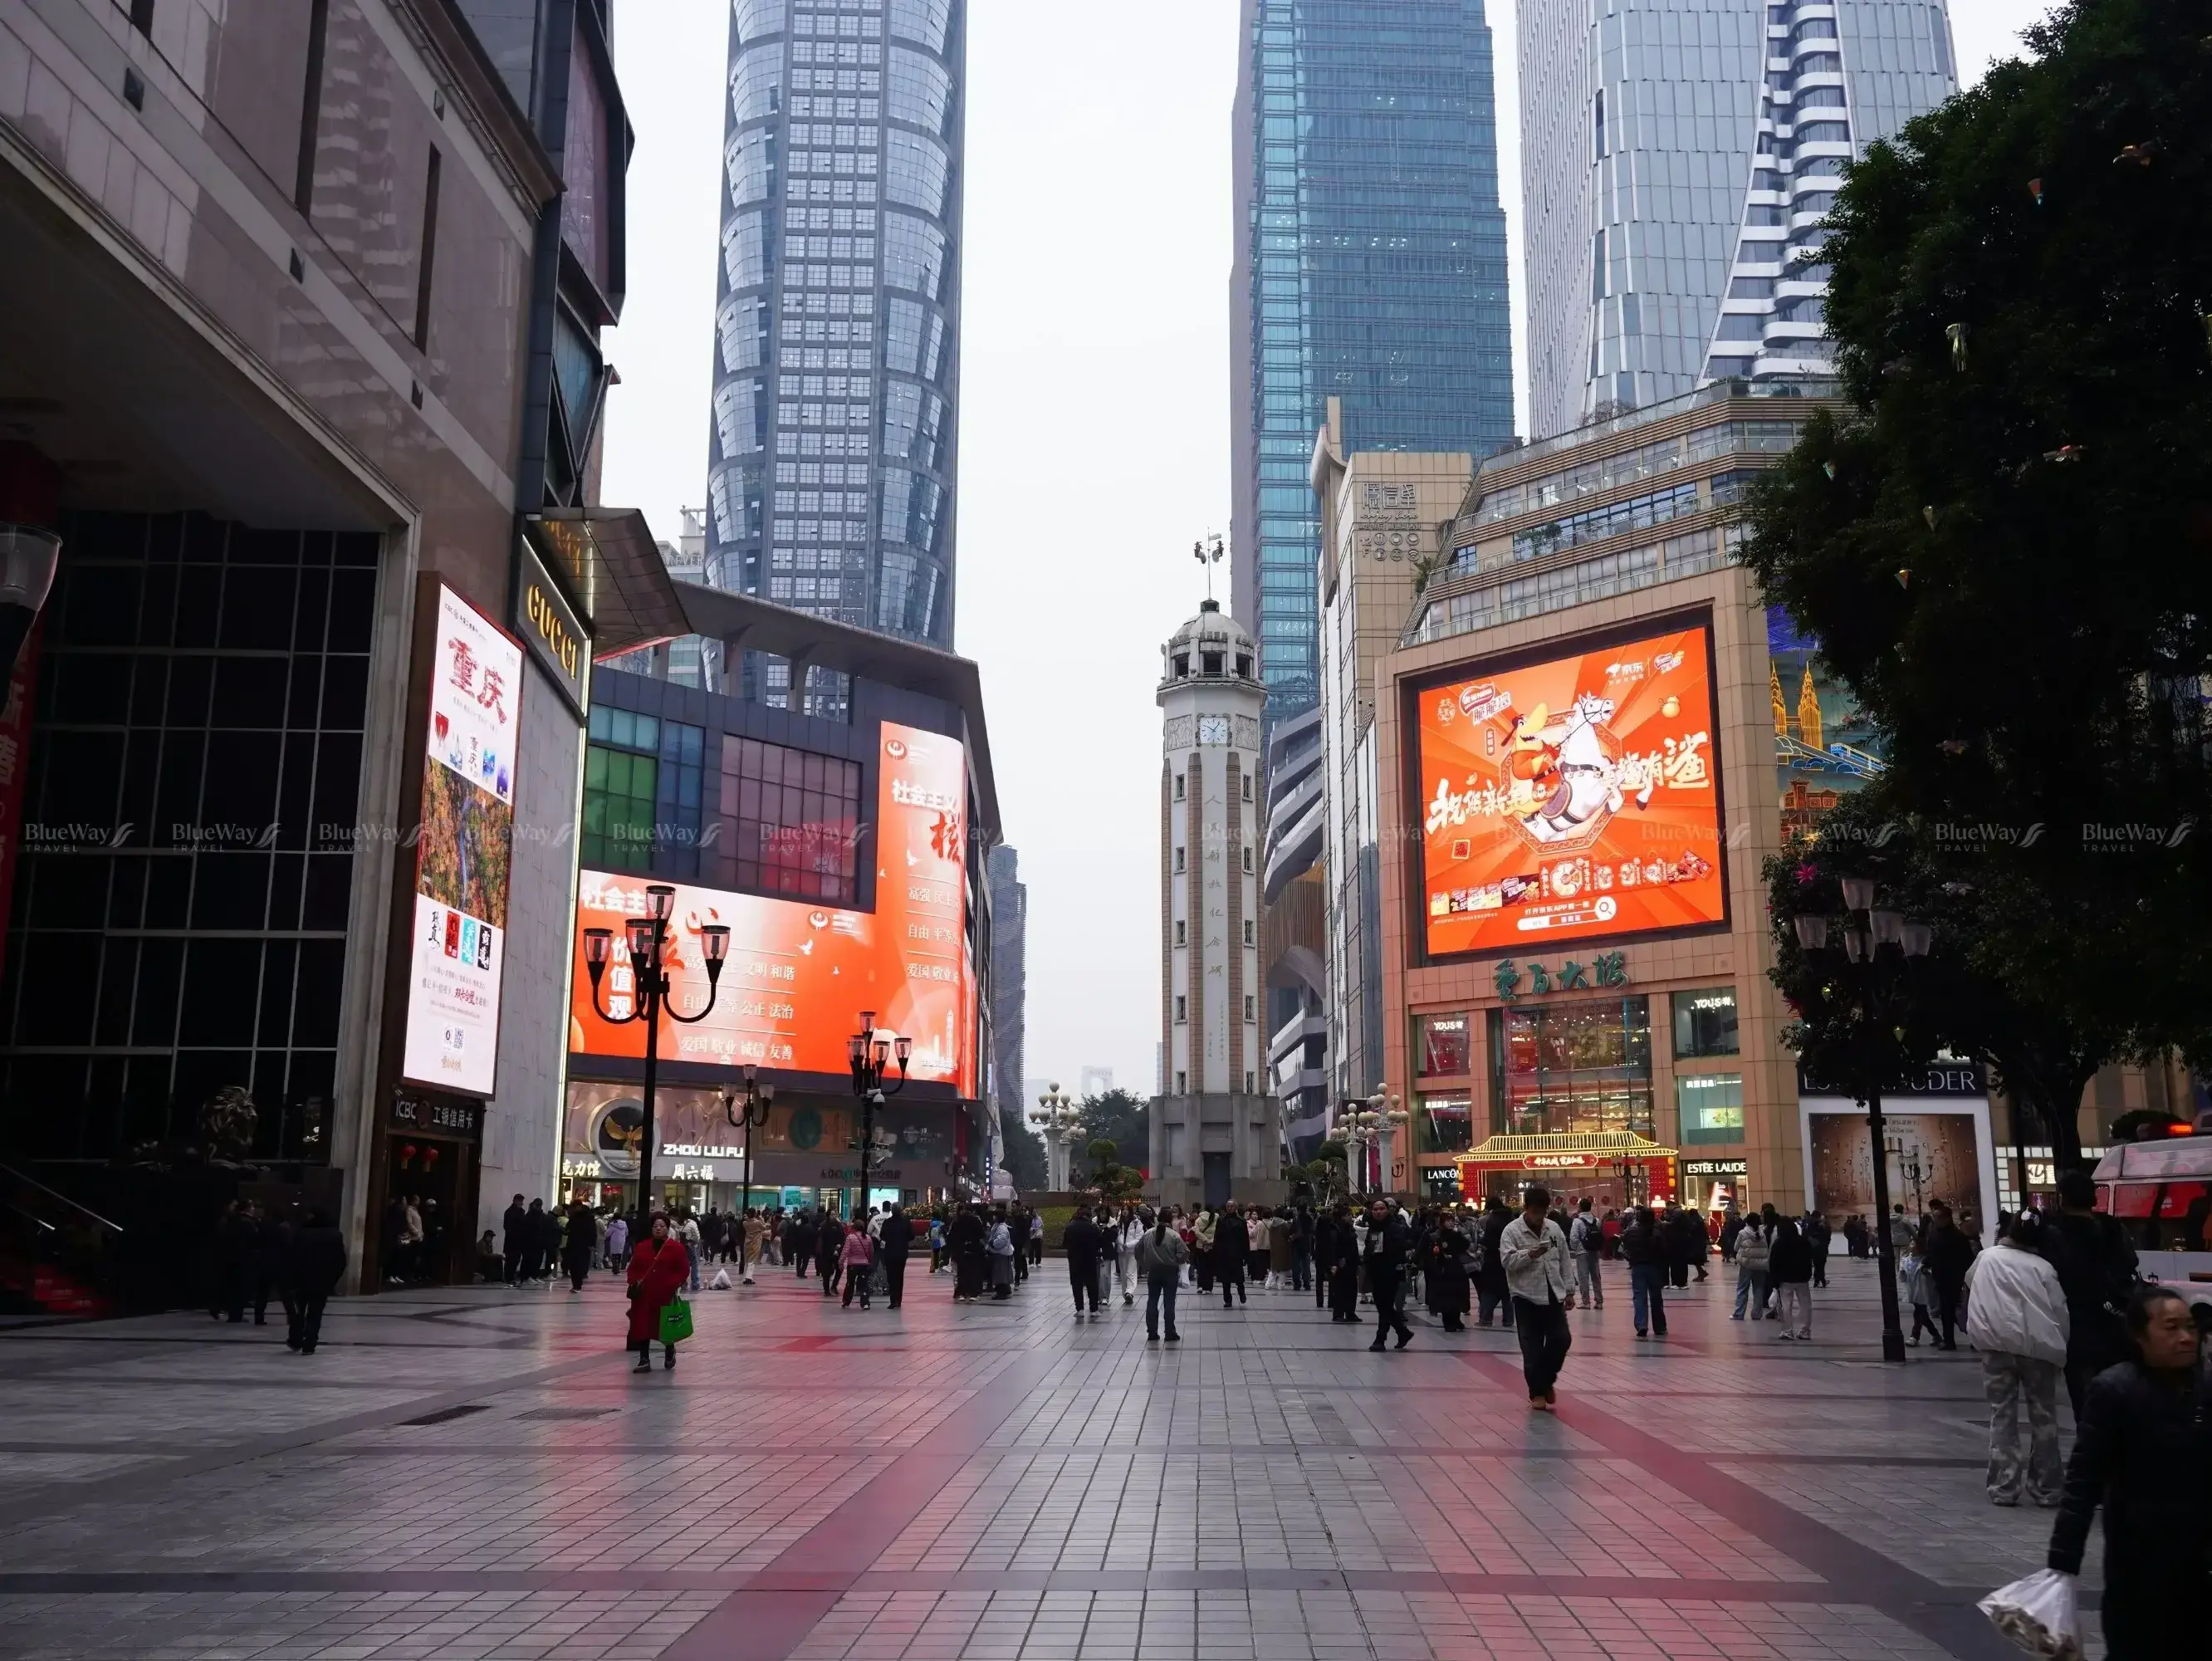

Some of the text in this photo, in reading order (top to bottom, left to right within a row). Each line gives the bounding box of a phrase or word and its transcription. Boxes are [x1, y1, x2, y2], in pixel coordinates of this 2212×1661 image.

[528, 584, 577, 679] GUCCI
[448, 636, 507, 724] 重庆
[582, 884, 646, 916] 社会主
[908, 924, 929, 940] 自由
[770, 963, 795, 981] 和谐
[741, 999, 766, 1017] 公正
[769, 1002, 794, 1020] 法治
[681, 1035, 707, 1053] 爱国
[740, 1040, 765, 1058] 诚信
[770, 1043, 793, 1061] 友善
[395, 1100, 473, 1129] ICBC 工银信用卡
[663, 1144, 744, 1157] ZHOU LIU FU
[672, 1164, 714, 1180] 周六福
[1428, 1168, 1463, 1179] LANCÔ
